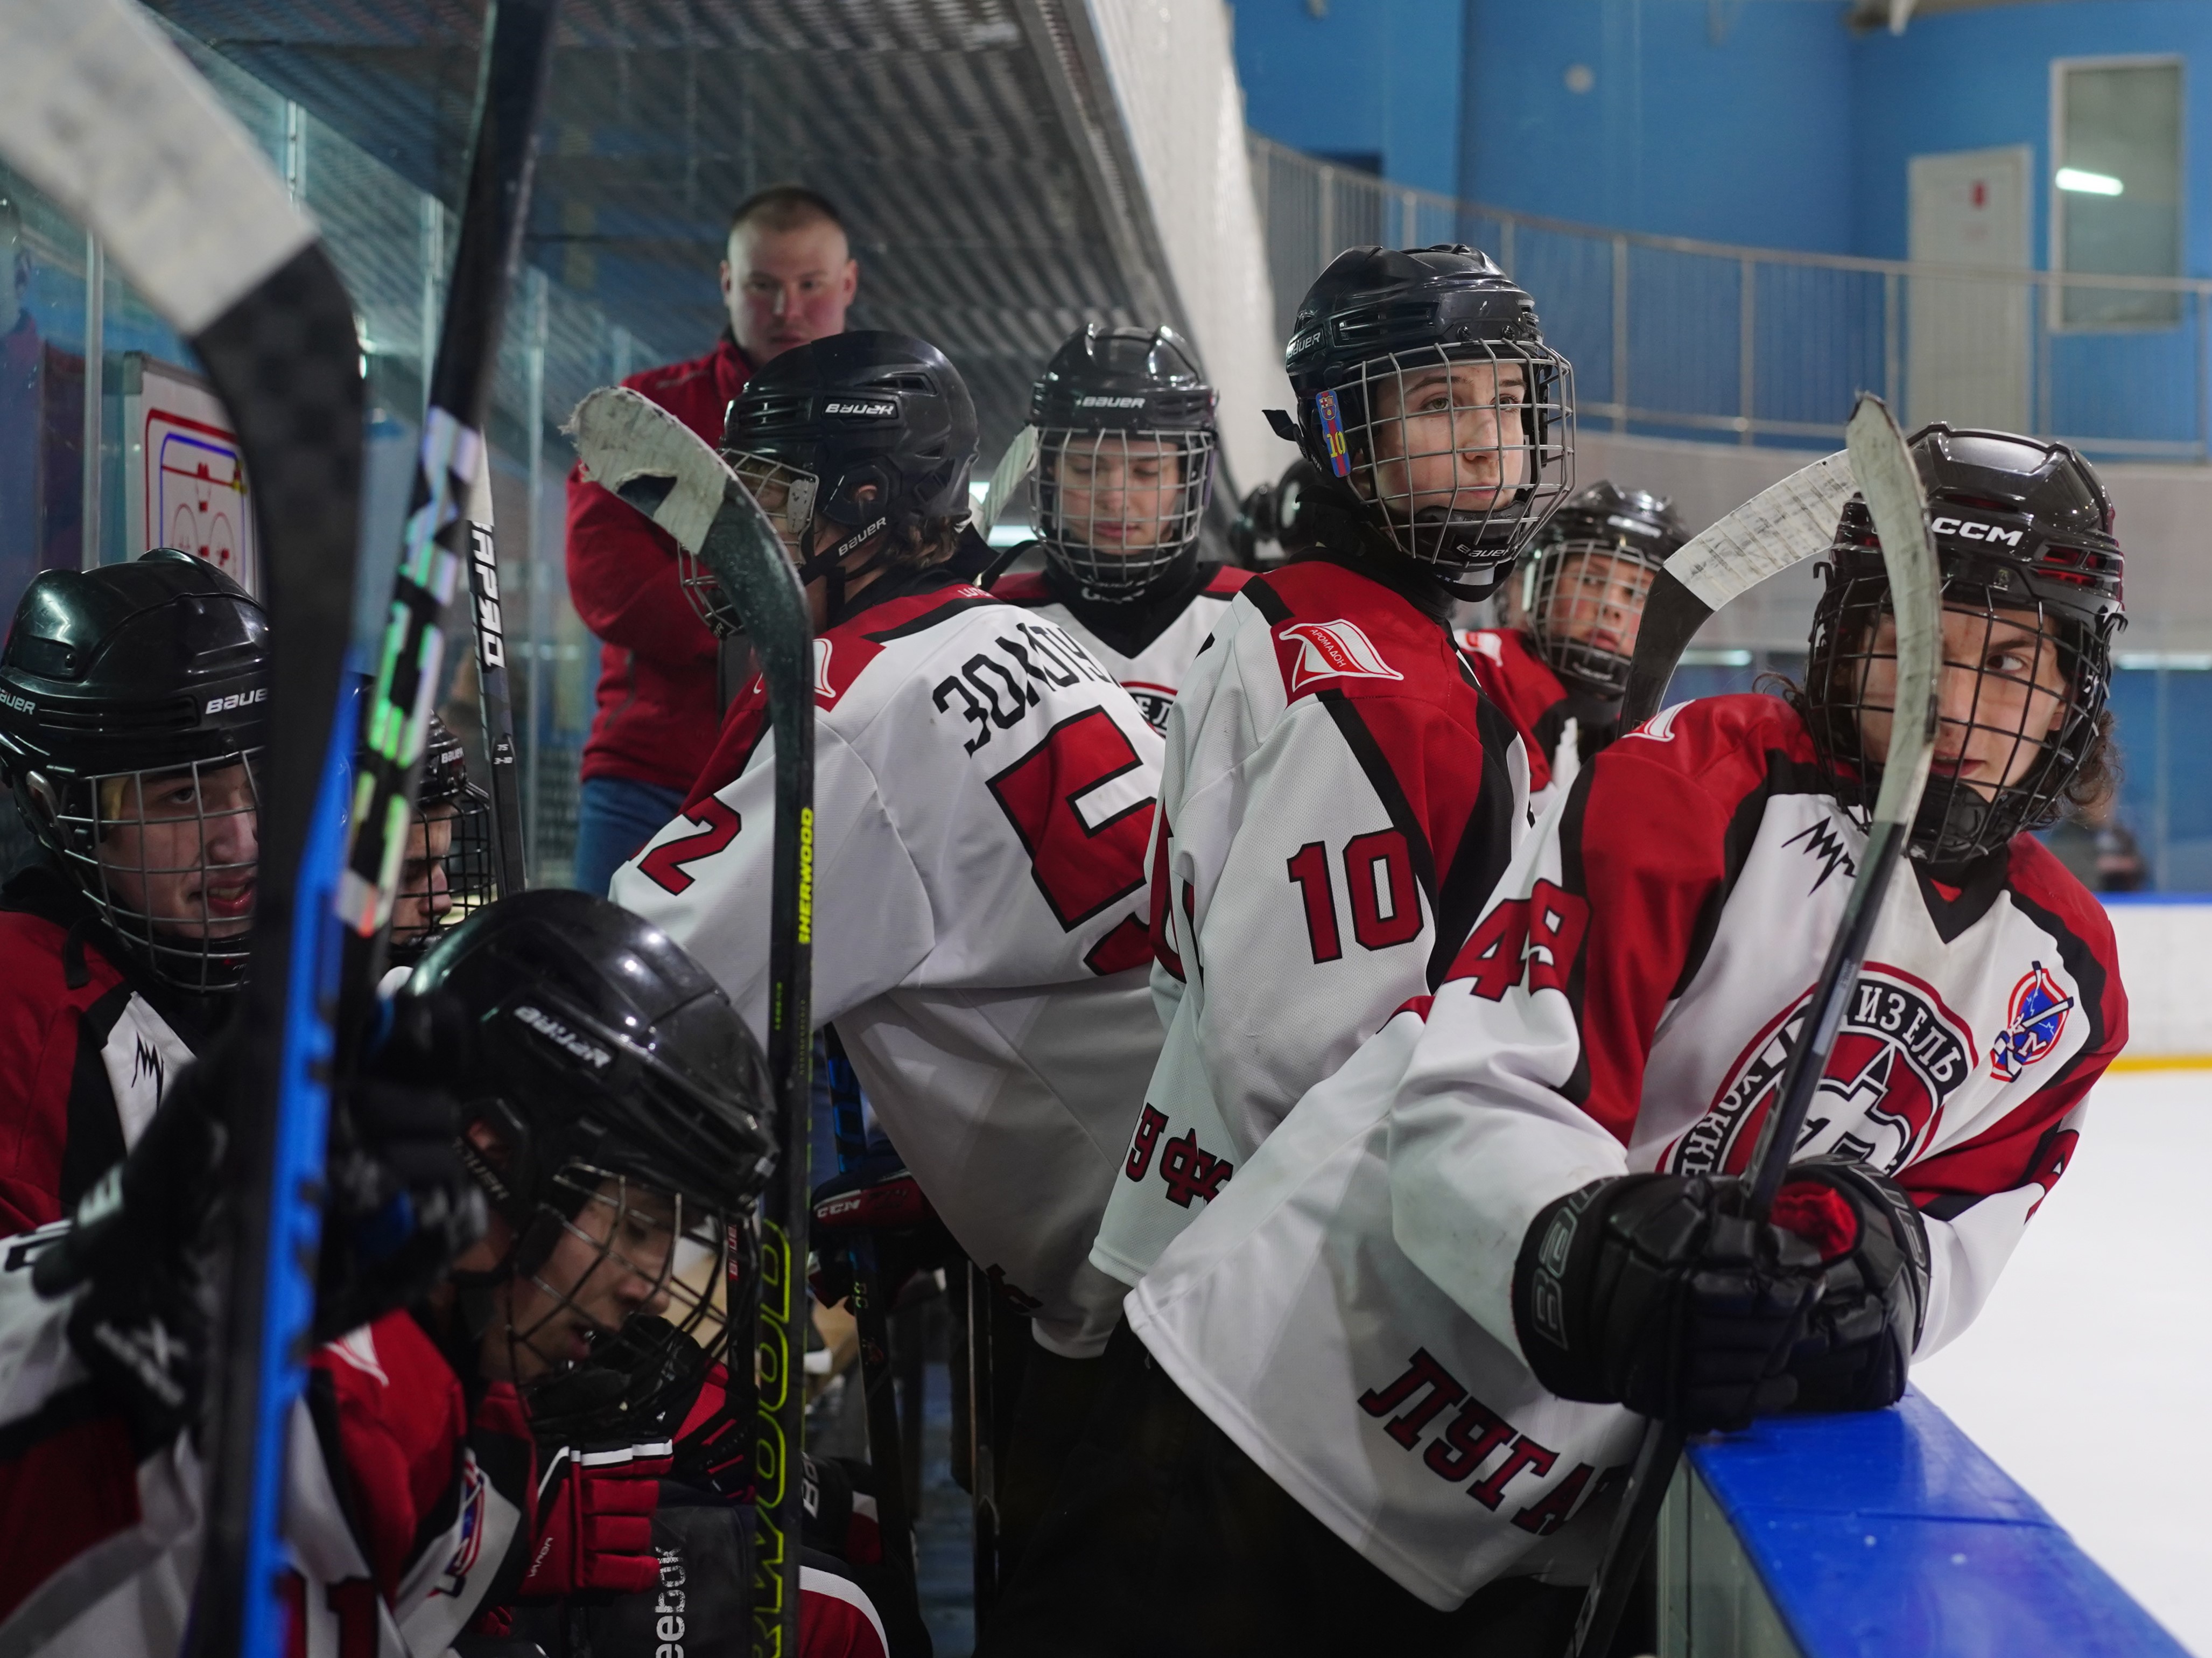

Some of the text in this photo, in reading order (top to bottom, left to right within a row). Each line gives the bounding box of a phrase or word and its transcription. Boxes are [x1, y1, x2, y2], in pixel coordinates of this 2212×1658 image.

[825, 402, 894, 416] BAUER
[1082, 395, 1146, 410] BAUER
[1325, 430, 1347, 458] 10
[838, 516, 887, 557] BAUER
[1931, 517, 2024, 547] CCM
[1309, 626, 1347, 670] АРОМАДОН
[0, 685, 36, 715] AUER
[205, 687, 269, 714] BAUE
[637, 794, 742, 897] 2
[798, 807, 814, 944] SHERWOOD
[1286, 826, 1424, 964] 10
[1843, 984, 1953, 1083] ИЗЕЛЬ
[817, 1199, 861, 1219] CCM
